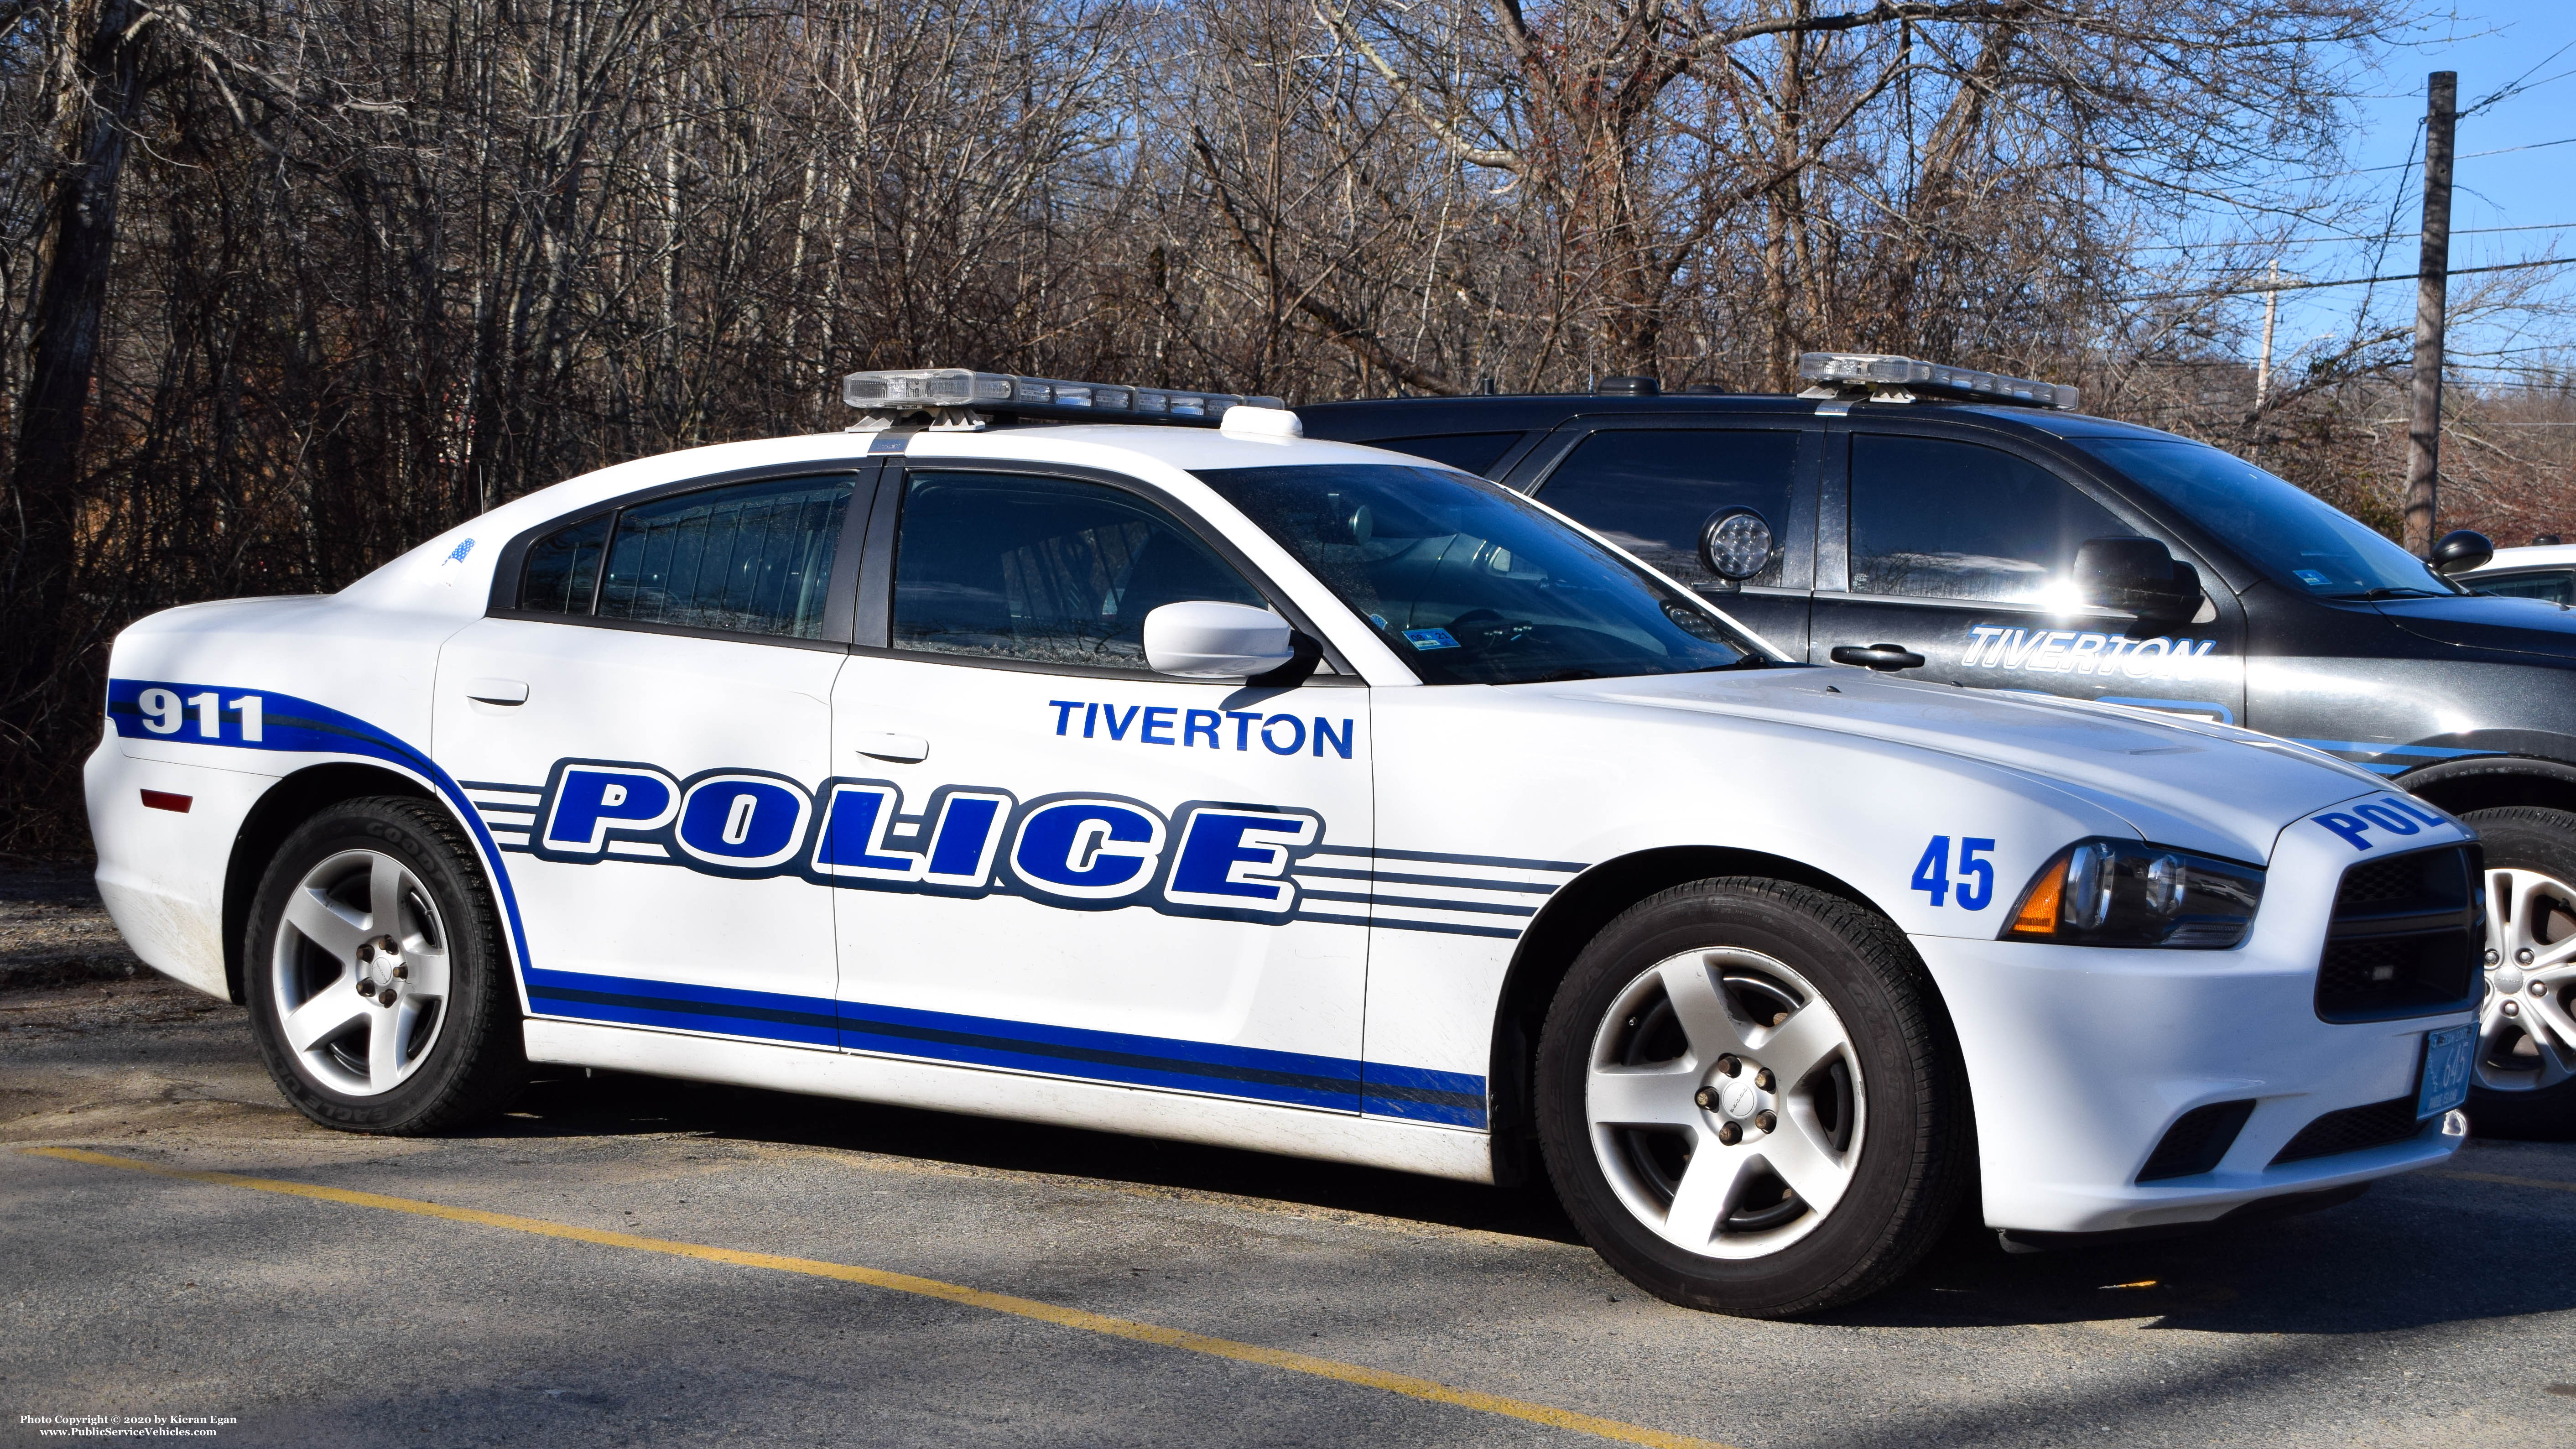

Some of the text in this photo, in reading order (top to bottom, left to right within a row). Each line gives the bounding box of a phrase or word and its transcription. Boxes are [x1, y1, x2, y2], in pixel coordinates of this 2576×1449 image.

[1961, 625, 2215, 681] TIVERTON
[138, 688, 262, 742] 911
[1049, 700, 1353, 760] TIVERTON
[542, 763, 1321, 913] POLICE
[1910, 835, 1995, 912] 45
